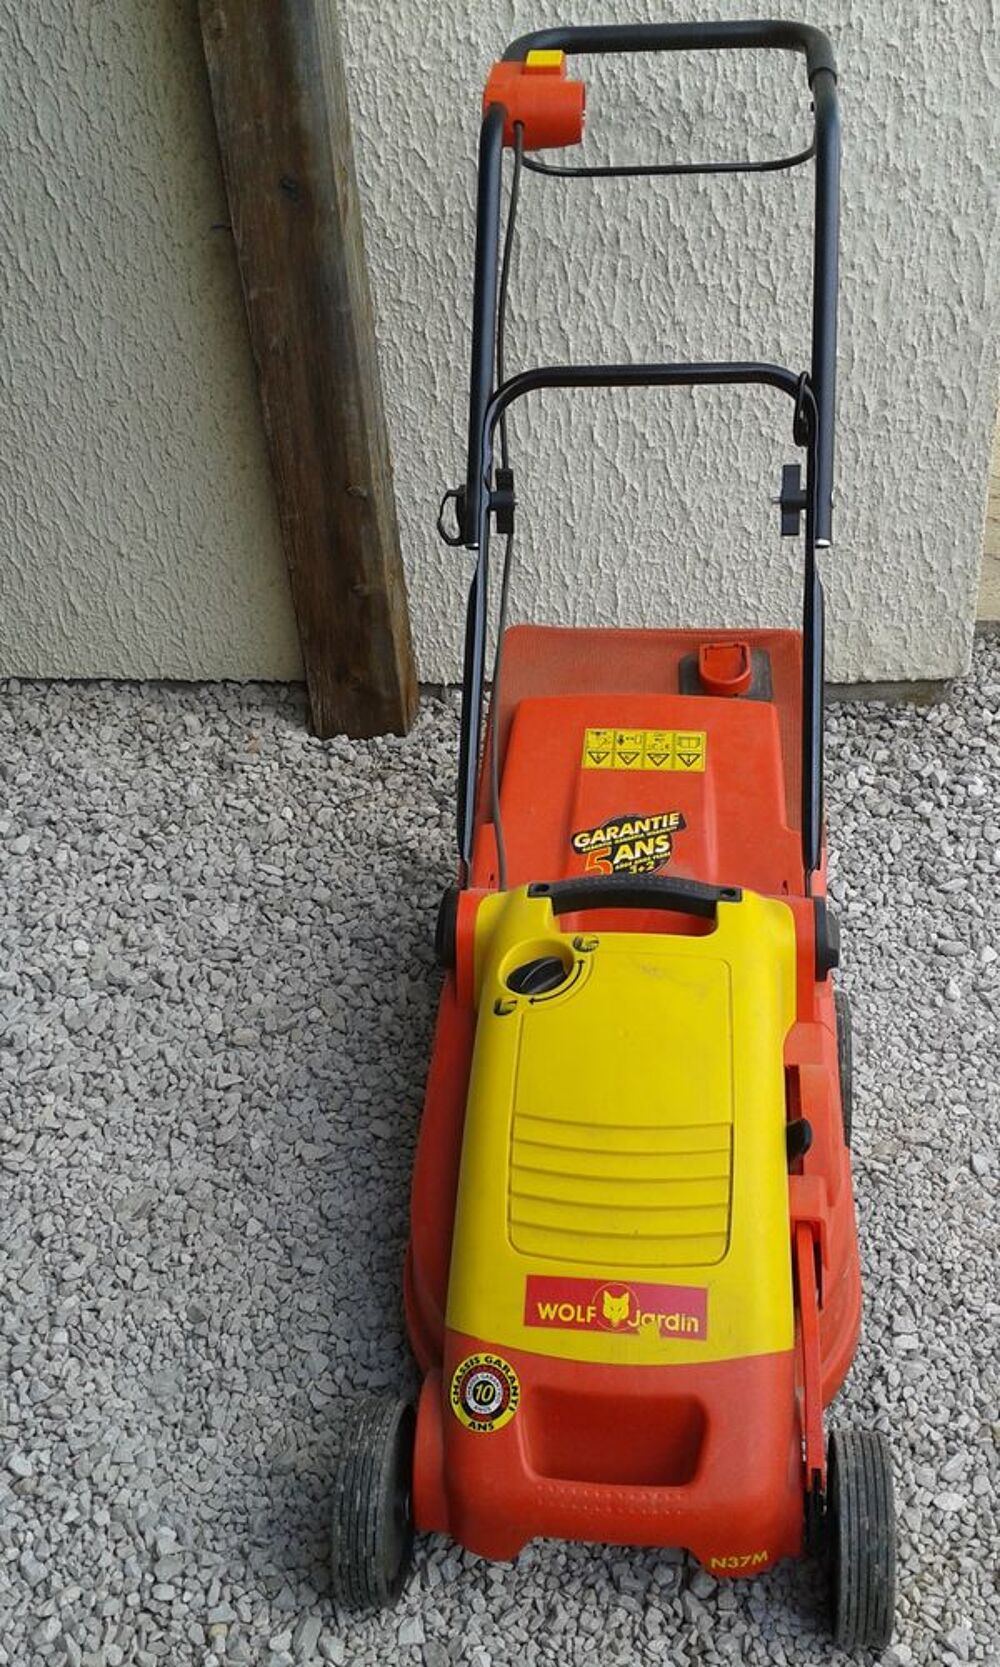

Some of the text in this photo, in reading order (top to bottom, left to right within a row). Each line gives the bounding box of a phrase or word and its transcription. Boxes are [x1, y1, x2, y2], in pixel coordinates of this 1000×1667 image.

[574, 812, 680, 848] GARANTIE
[585, 846, 614, 876] 5
[613, 834, 670, 864] ANS
[537, 1302, 597, 1323] WOLF
[452, 1356, 481, 1405] CHASSIS
[484, 1355, 519, 1412] GARANTI
[475, 1384, 495, 1403] 10
[468, 1421, 495, 1431] ANS
[711, 1549, 768, 1570] N37M
